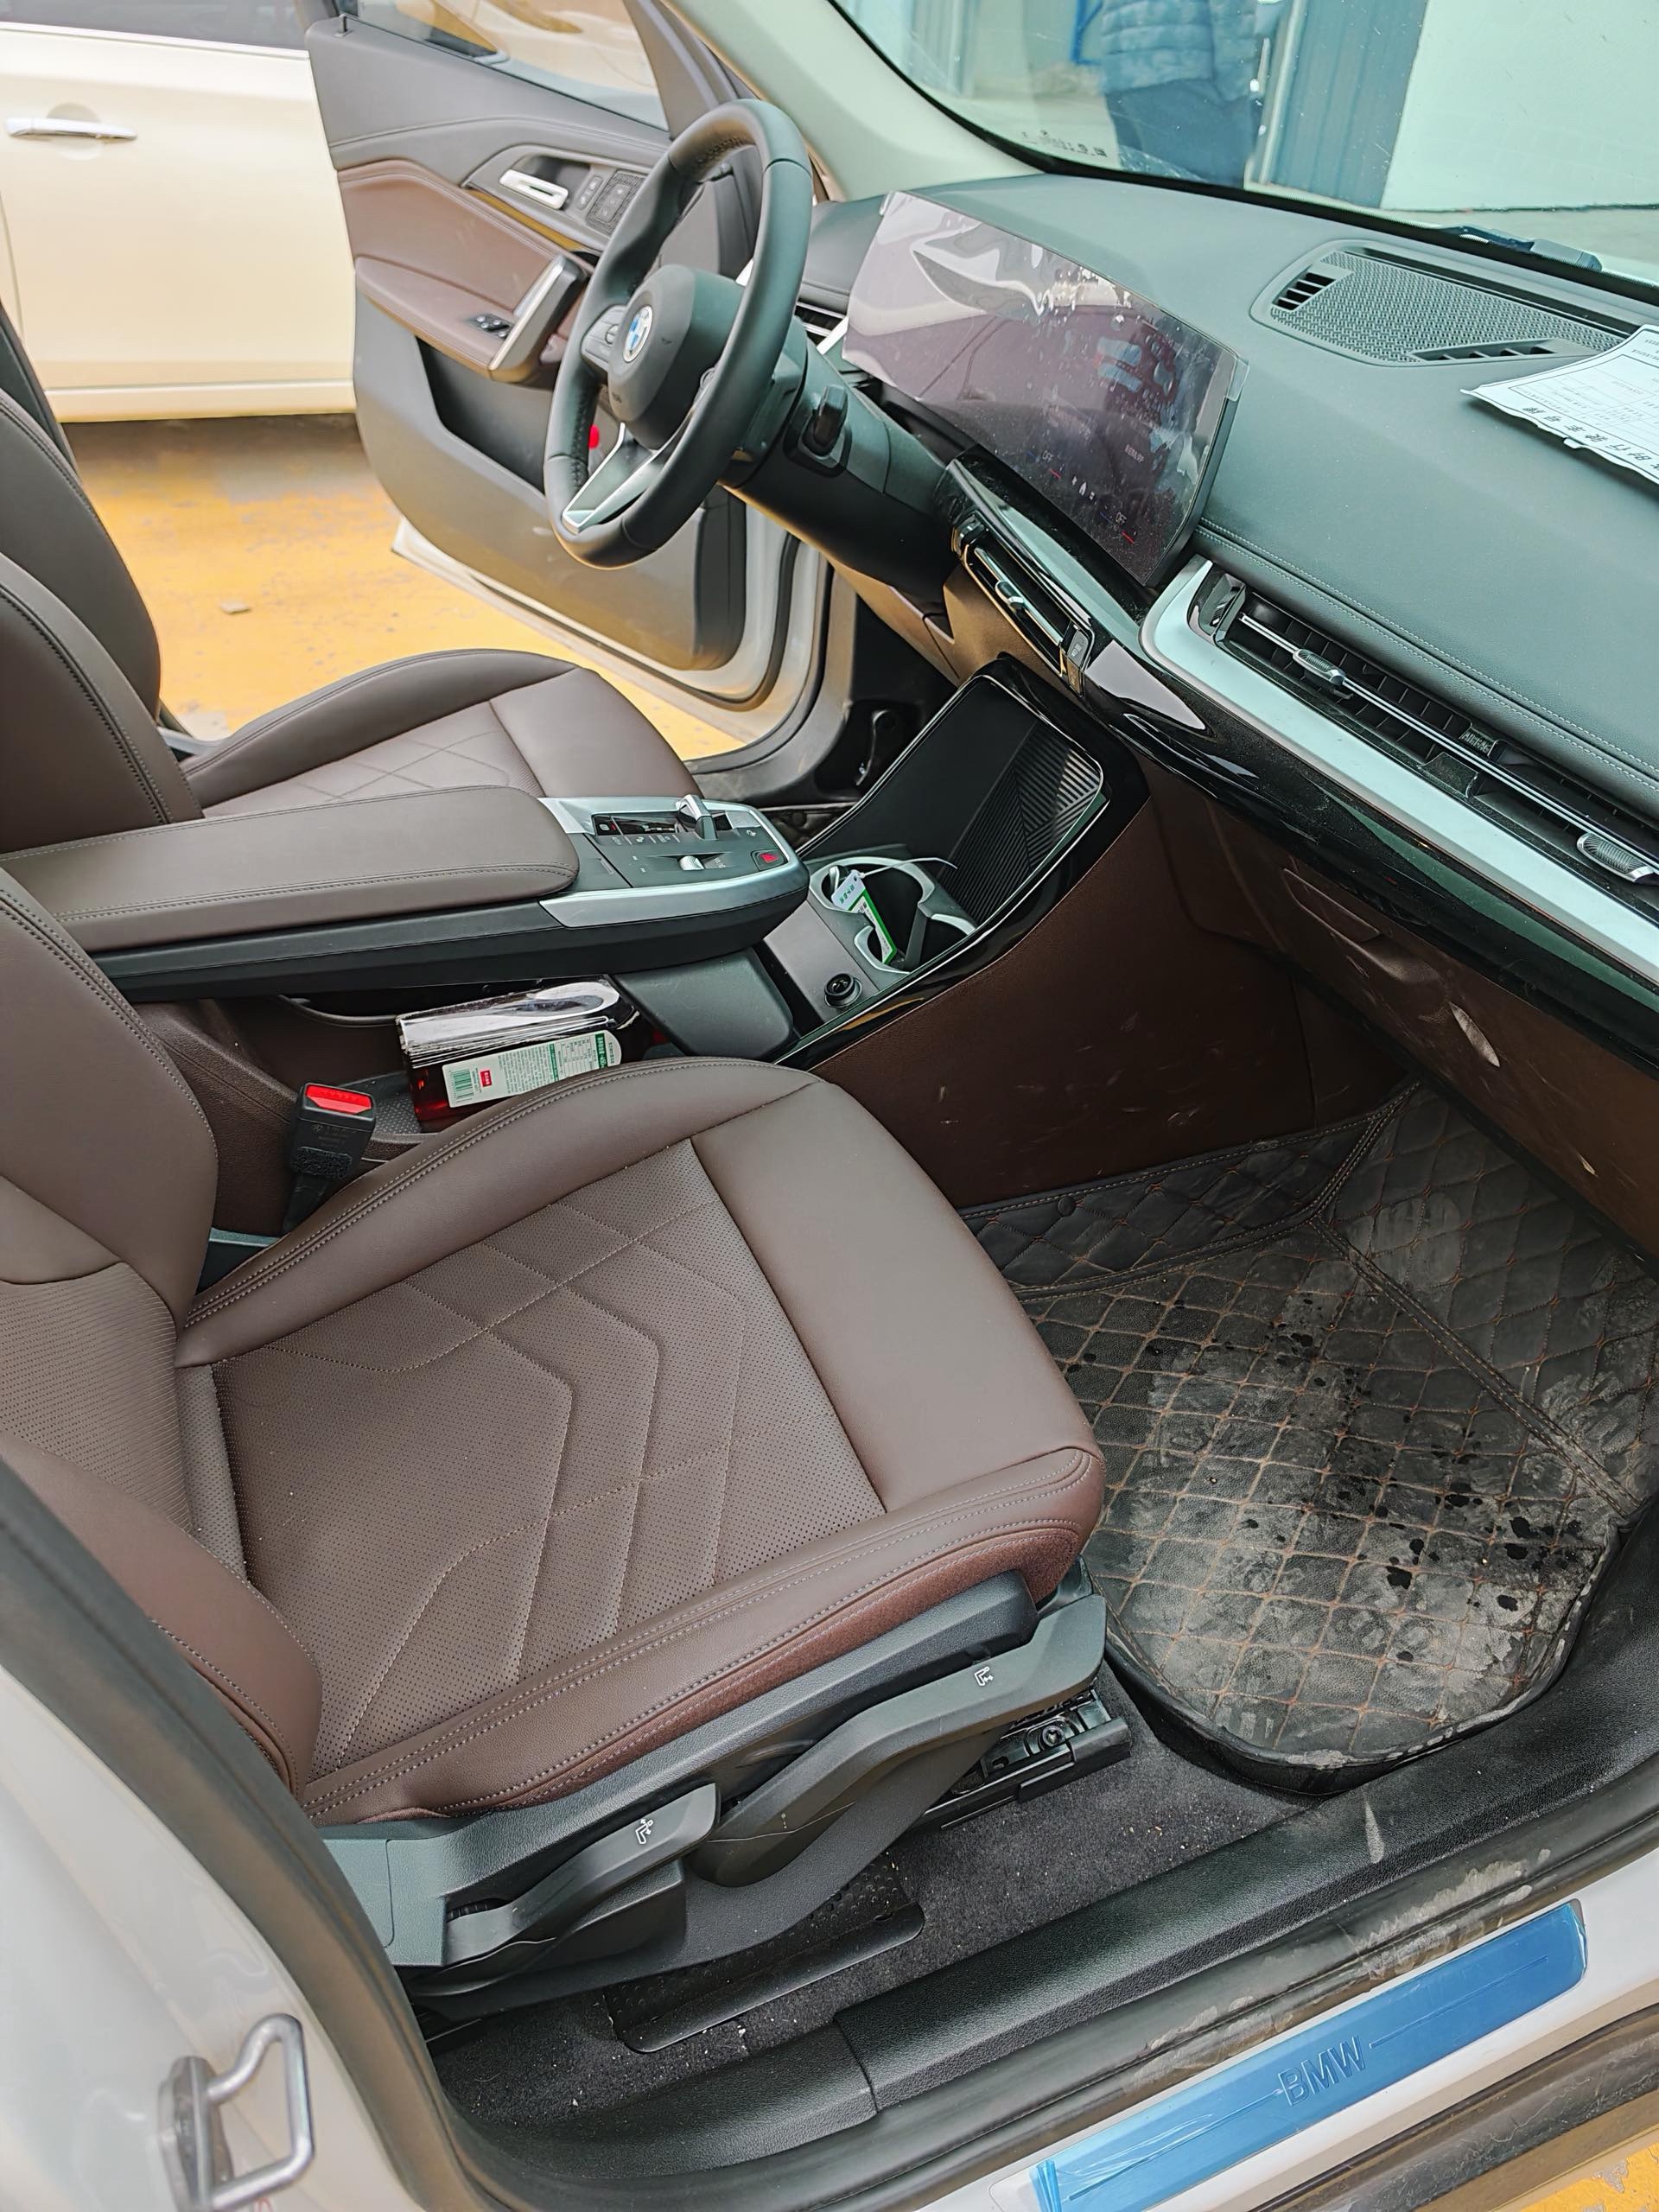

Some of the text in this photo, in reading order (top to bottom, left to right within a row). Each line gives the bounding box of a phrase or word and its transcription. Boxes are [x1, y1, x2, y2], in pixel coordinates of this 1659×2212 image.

[1116, 512, 1127, 525] OFF
[1461, 732, 1492, 753] AIRBAG
[1278, 2034, 1366, 2107] BMW
